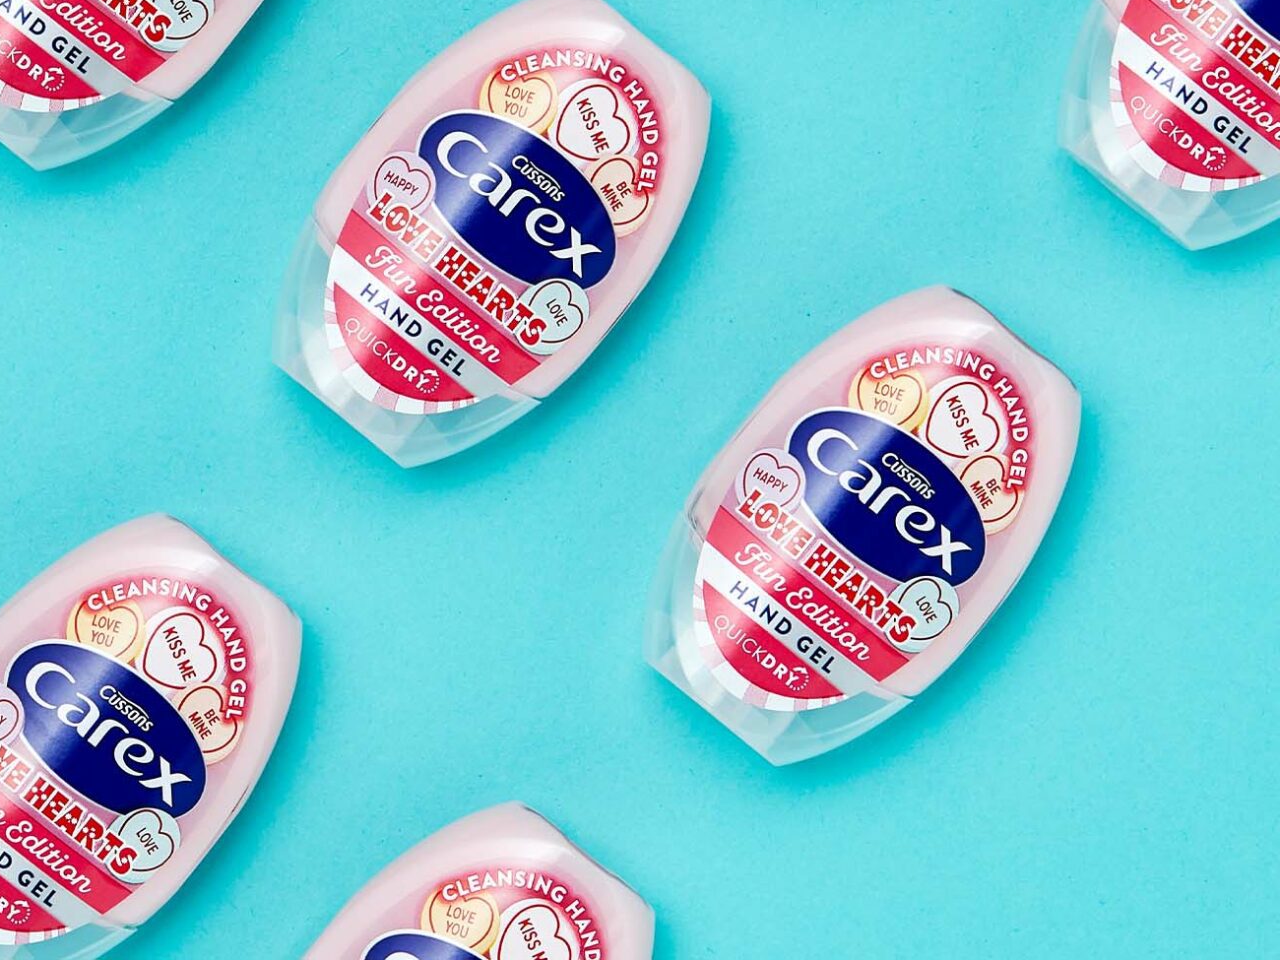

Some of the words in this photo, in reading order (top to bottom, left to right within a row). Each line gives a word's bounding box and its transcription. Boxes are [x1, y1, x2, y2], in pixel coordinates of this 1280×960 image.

[53, 35, 93, 74] GEL
[501, 50, 625, 82] CLEANSING
[1150, 23, 1202, 71] Fun
[1220, 23, 1280, 90] HEA
[577, 98, 600, 130] KISS
[591, 130, 610, 153] ME
[624, 79, 659, 144] HAND
[1146, 61, 1208, 115] HAND
[1214, 115, 1255, 154] GEL
[384, 172, 419, 196] HAPPY
[512, 154, 565, 202] Cussons
[615, 181, 632, 198] BE
[637, 152, 659, 193] GEL
[437, 131, 602, 278] Carex
[600, 183, 623, 212] MINE
[369, 194, 443, 259] LOVE
[436, 244, 547, 346] HEARTS
[365, 245, 417, 293] Fun
[416, 289, 501, 364] Edition
[546, 299, 568, 328] LOVE
[360, 283, 422, 337] HAND
[428, 338, 468, 377] GEL
[871, 349, 995, 381] CLEANSING
[947, 396, 970, 428] KISS
[961, 428, 979, 451] ME
[994, 377, 1029, 442] HAND
[754, 468, 788, 491] HAPPY
[882, 452, 935, 500] Cussons
[1007, 449, 1028, 489] GEL
[807, 430, 972, 576] Carex
[739, 489, 813, 554] LOVE
[806, 542, 917, 644] HEARTS
[87, 579, 211, 611] CLEANSING
[735, 544, 787, 592] Fun
[786, 587, 870, 662] Edition
[915, 596, 938, 625] LOVE
[211, 607, 246, 672] HAND
[730, 582, 792, 635] HAND
[798, 635, 838, 674] GEL
[100, 683, 153, 732] Cussons
[204, 709, 220, 726] BE
[225, 680, 247, 720] GEL
[25, 661, 191, 808] Carex
[189, 711, 212, 741] MINE
[26, 774, 137, 876] HEARTS
[136, 828, 158, 857] LOVE
[6, 820, 91, 895] Edition
[18, 869, 59, 908] GEL
[442, 870, 567, 902] CLEANSING
[446, 906, 477, 924] LOVE
[446, 921, 470, 938] YOU
[518, 918, 541, 951] KISS
